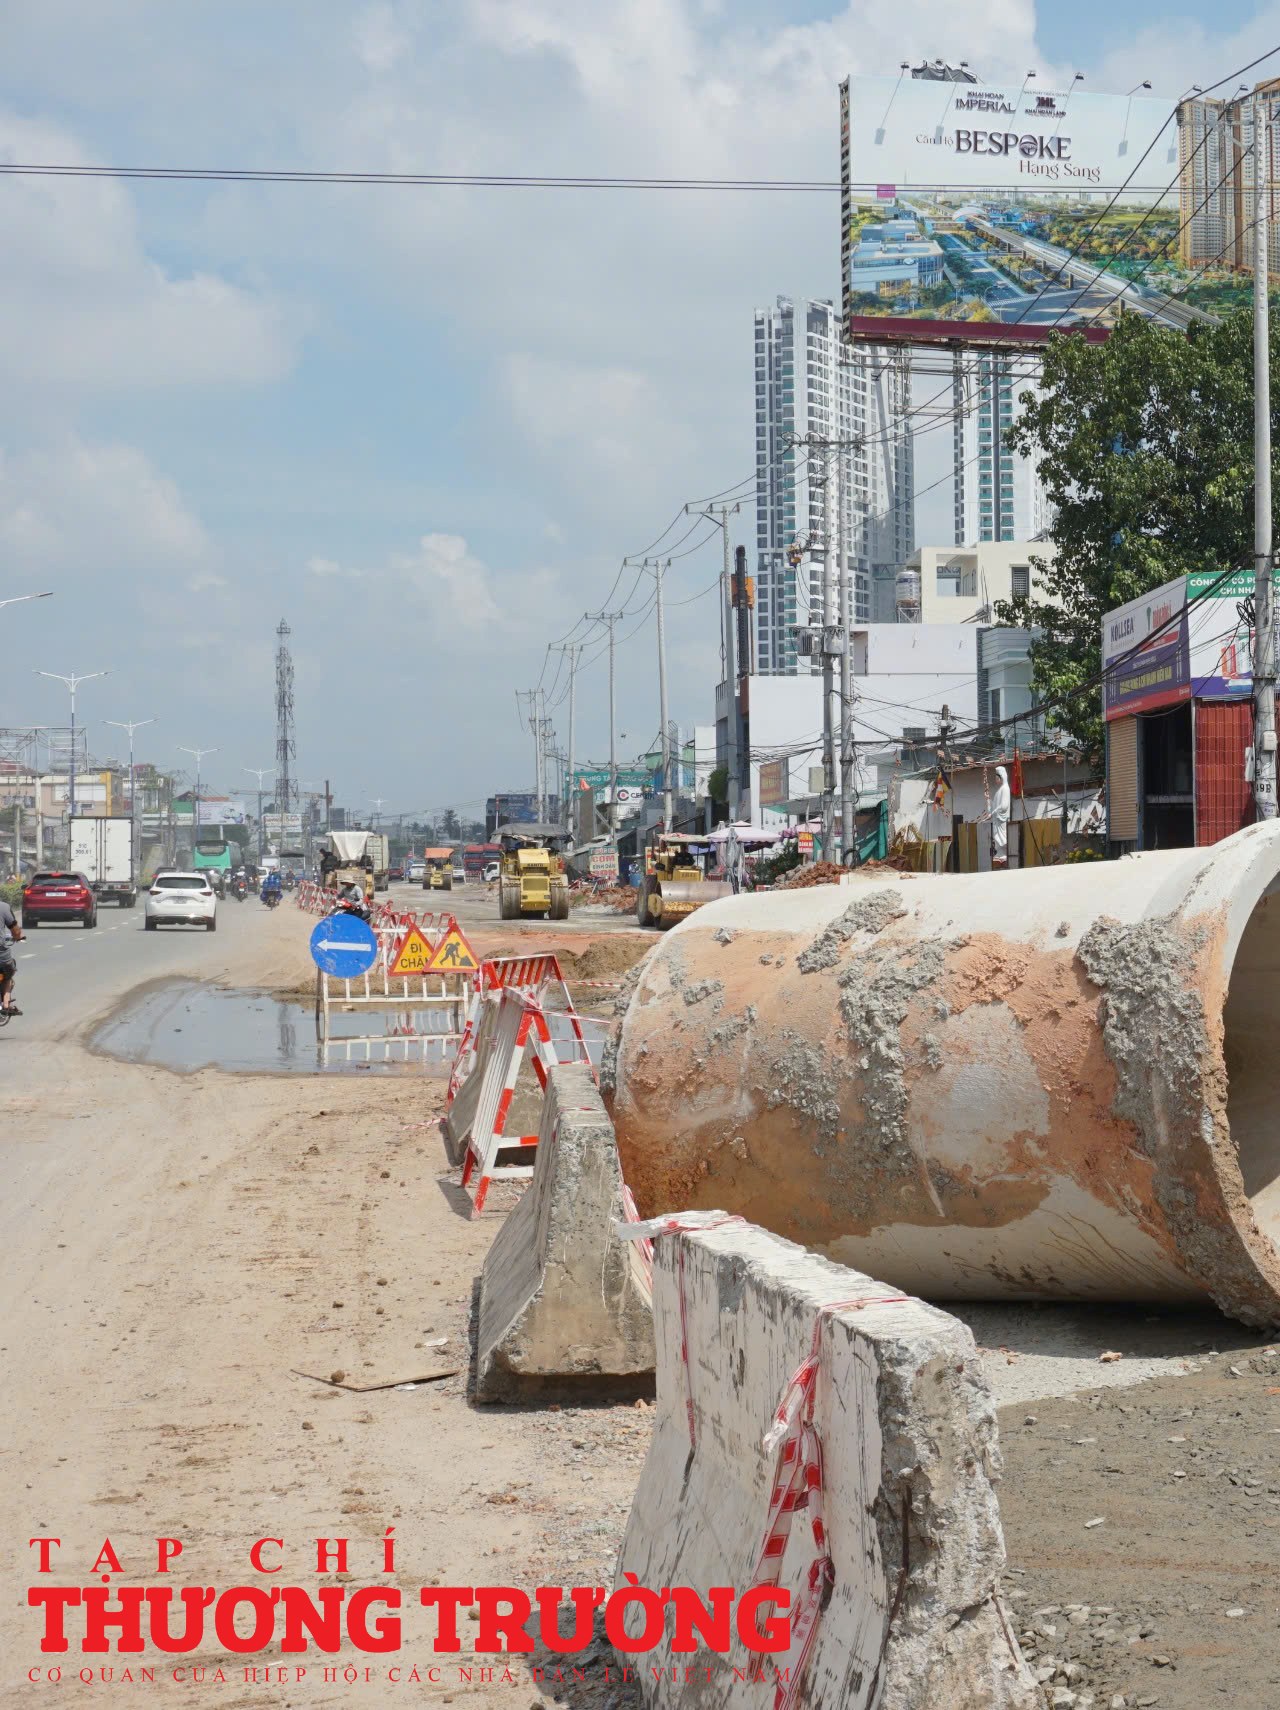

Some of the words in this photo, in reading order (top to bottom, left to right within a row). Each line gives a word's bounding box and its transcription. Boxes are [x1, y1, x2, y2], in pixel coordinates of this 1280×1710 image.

[956, 98, 1016, 114] IMPERIAL
[955, 129, 1071, 159] BESPOKE
[1020, 160, 1059, 180] Hạng
[1063, 163, 1101, 183] Sang
[410, 943, 422, 953] ĐI
[400, 955, 429, 970] CHẬ
